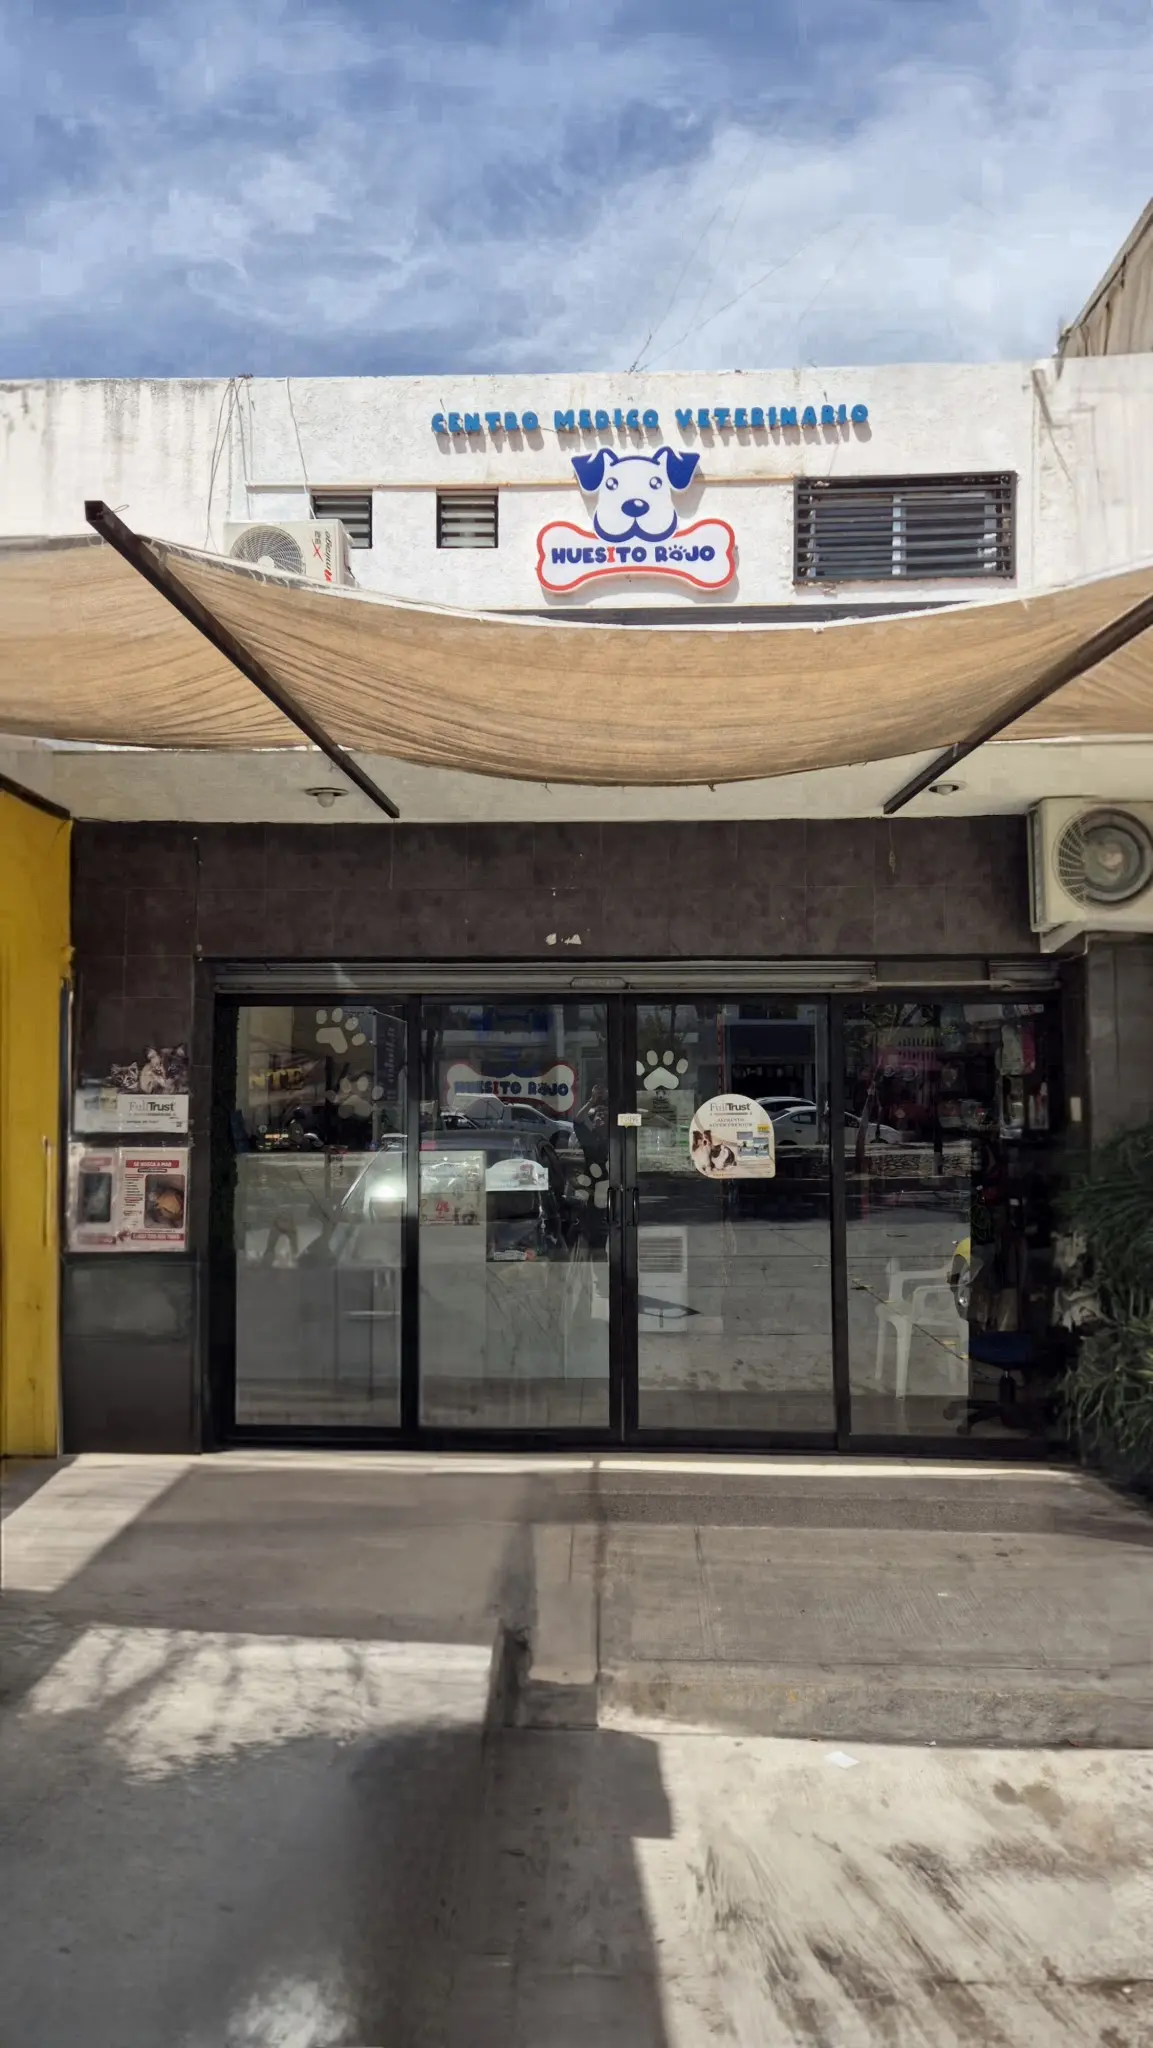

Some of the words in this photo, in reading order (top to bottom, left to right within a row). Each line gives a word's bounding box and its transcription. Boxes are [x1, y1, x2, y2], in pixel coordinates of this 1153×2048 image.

[431, 411, 538, 432] CENTRO
[553, 408, 659, 430] MEDICO
[674, 404, 868, 429] VETERINARIO
[551, 547, 647, 564] HUESITO
[454, 1081, 522, 1094] SITO
